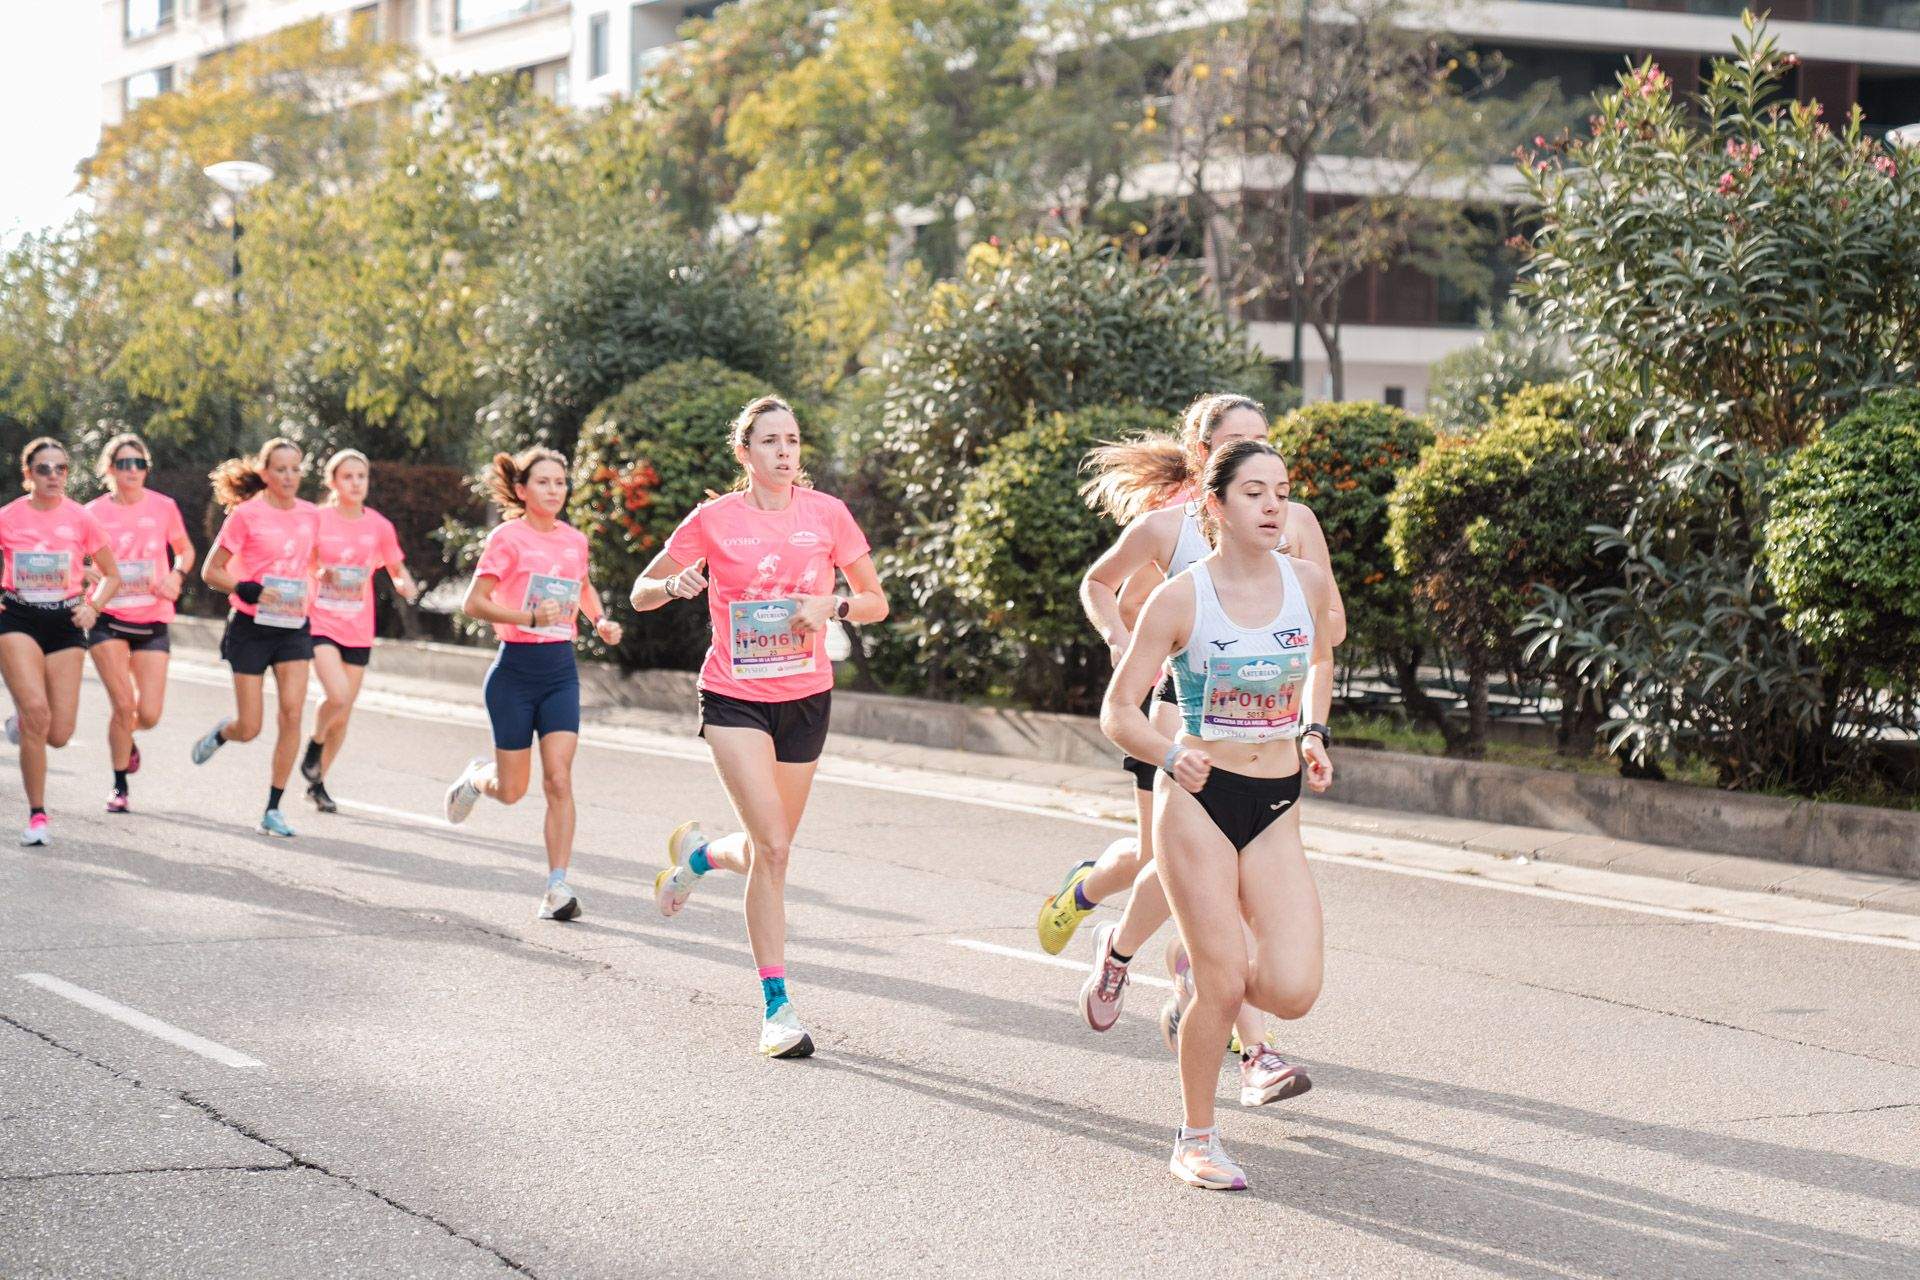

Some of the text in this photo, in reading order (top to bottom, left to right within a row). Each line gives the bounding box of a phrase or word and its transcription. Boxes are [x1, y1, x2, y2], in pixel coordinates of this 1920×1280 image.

[758, 633, 789, 648] 016
[1240, 667, 1280, 677] ASTURIANA
[1239, 692, 1276, 709] 016
